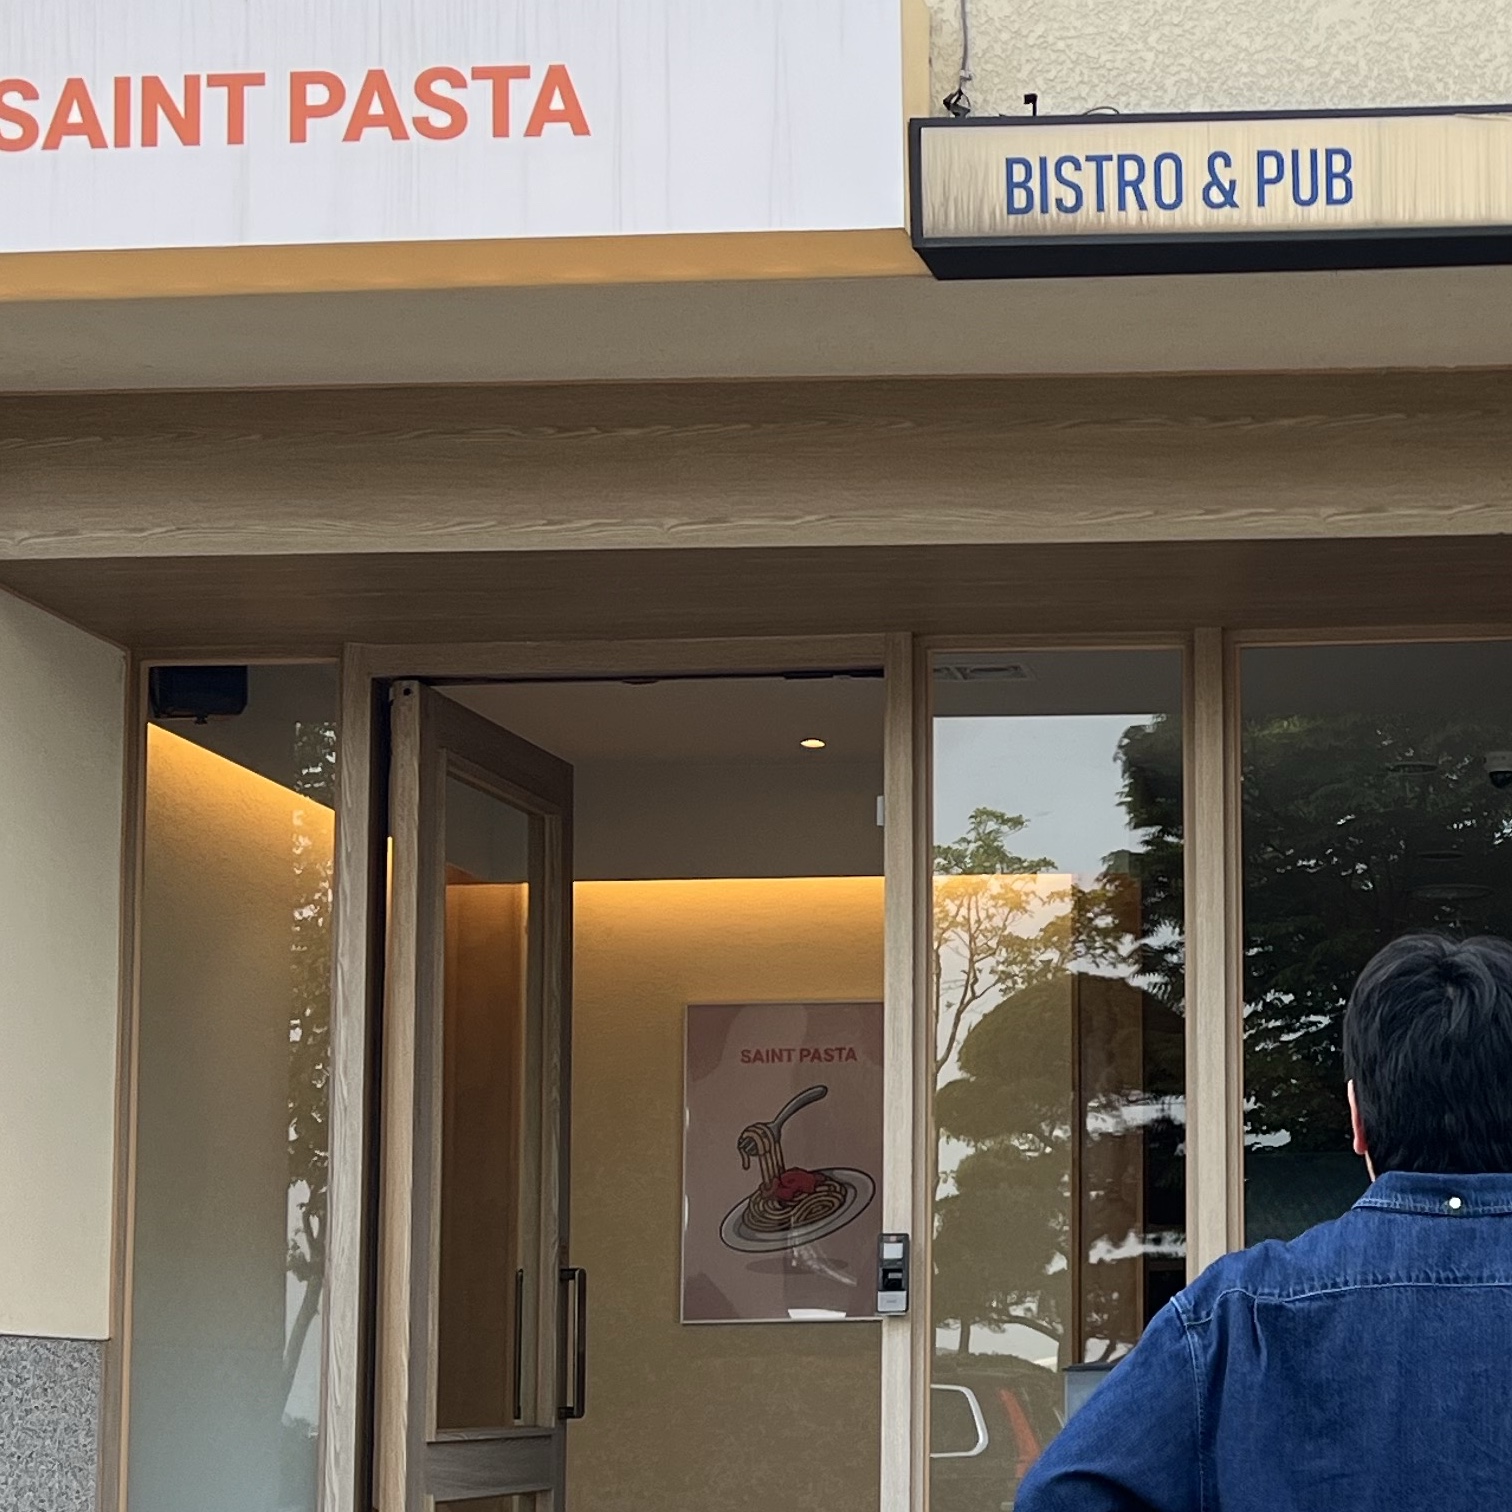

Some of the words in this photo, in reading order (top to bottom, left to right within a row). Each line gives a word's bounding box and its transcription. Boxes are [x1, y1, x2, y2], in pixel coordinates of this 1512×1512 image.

[0, 71, 266, 152] SAINT
[289, 64, 592, 144] PASTA
[1005, 153, 1183, 216] BISTRO
[1202, 152, 1239, 210] &
[1256, 147, 1355, 208] PUB
[740, 1049, 795, 1064] SAINT
[799, 1047, 858, 1063] PASTA
